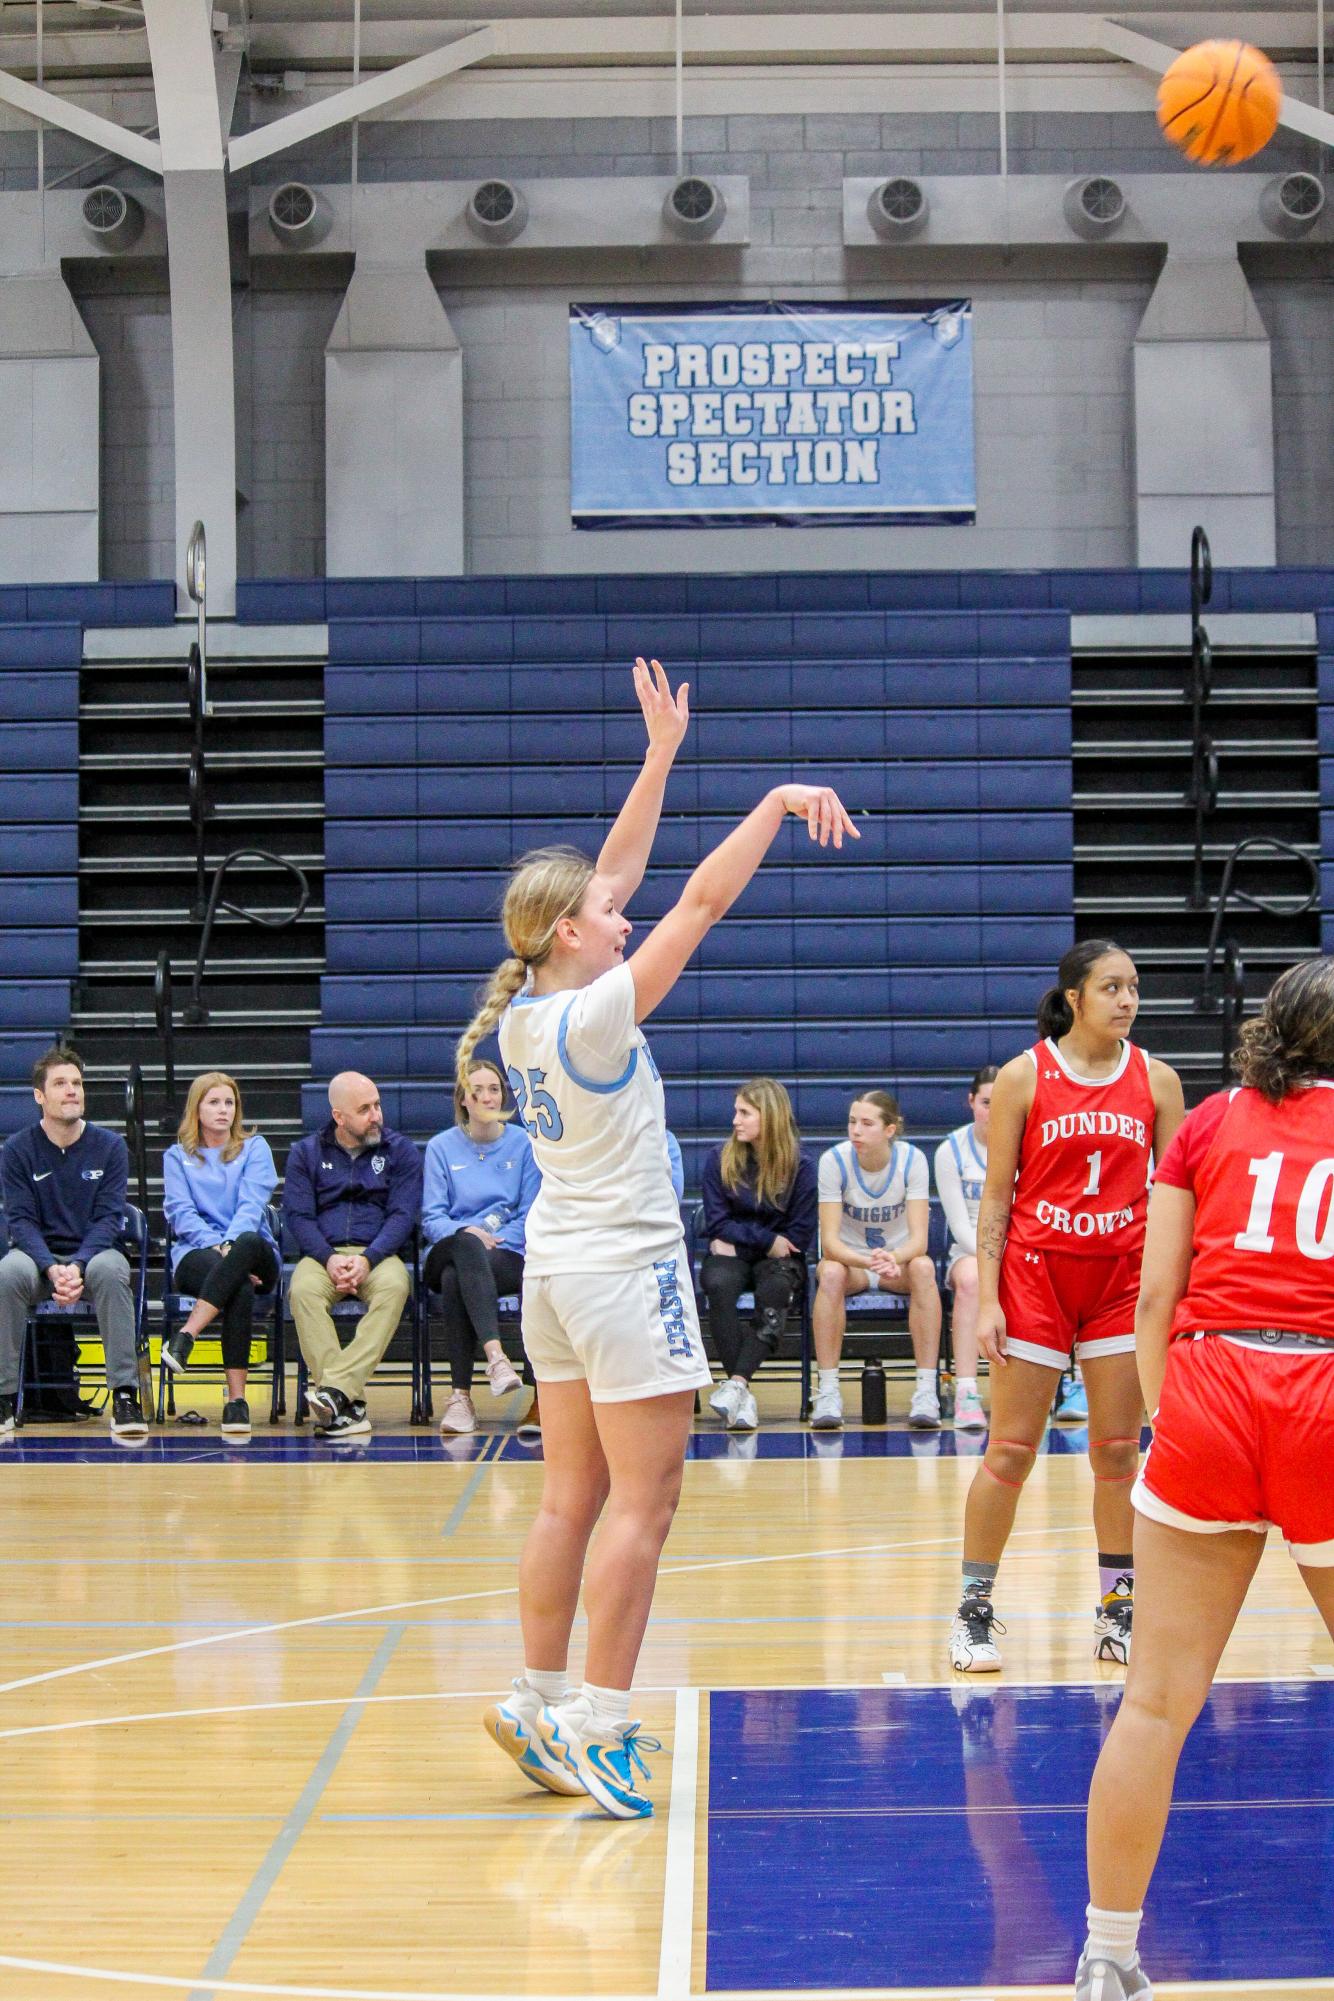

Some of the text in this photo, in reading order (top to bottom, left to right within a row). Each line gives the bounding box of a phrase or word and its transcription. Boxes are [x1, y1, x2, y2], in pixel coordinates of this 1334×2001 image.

[642, 342, 900, 389] PROSPECT
[627, 388, 917, 437] SPECTATOR
[666, 438, 880, 486] SECTION
[507, 1064, 564, 1142] 25
[1041, 1111, 1145, 1148] DUNDEE
[1082, 1150, 1102, 1195] 1
[1036, 1200, 1134, 1237] CROWN
[1233, 1151, 1334, 1261] 10
[864, 1227, 886, 1249] 5
[653, 1259, 693, 1358] PROSPECT
